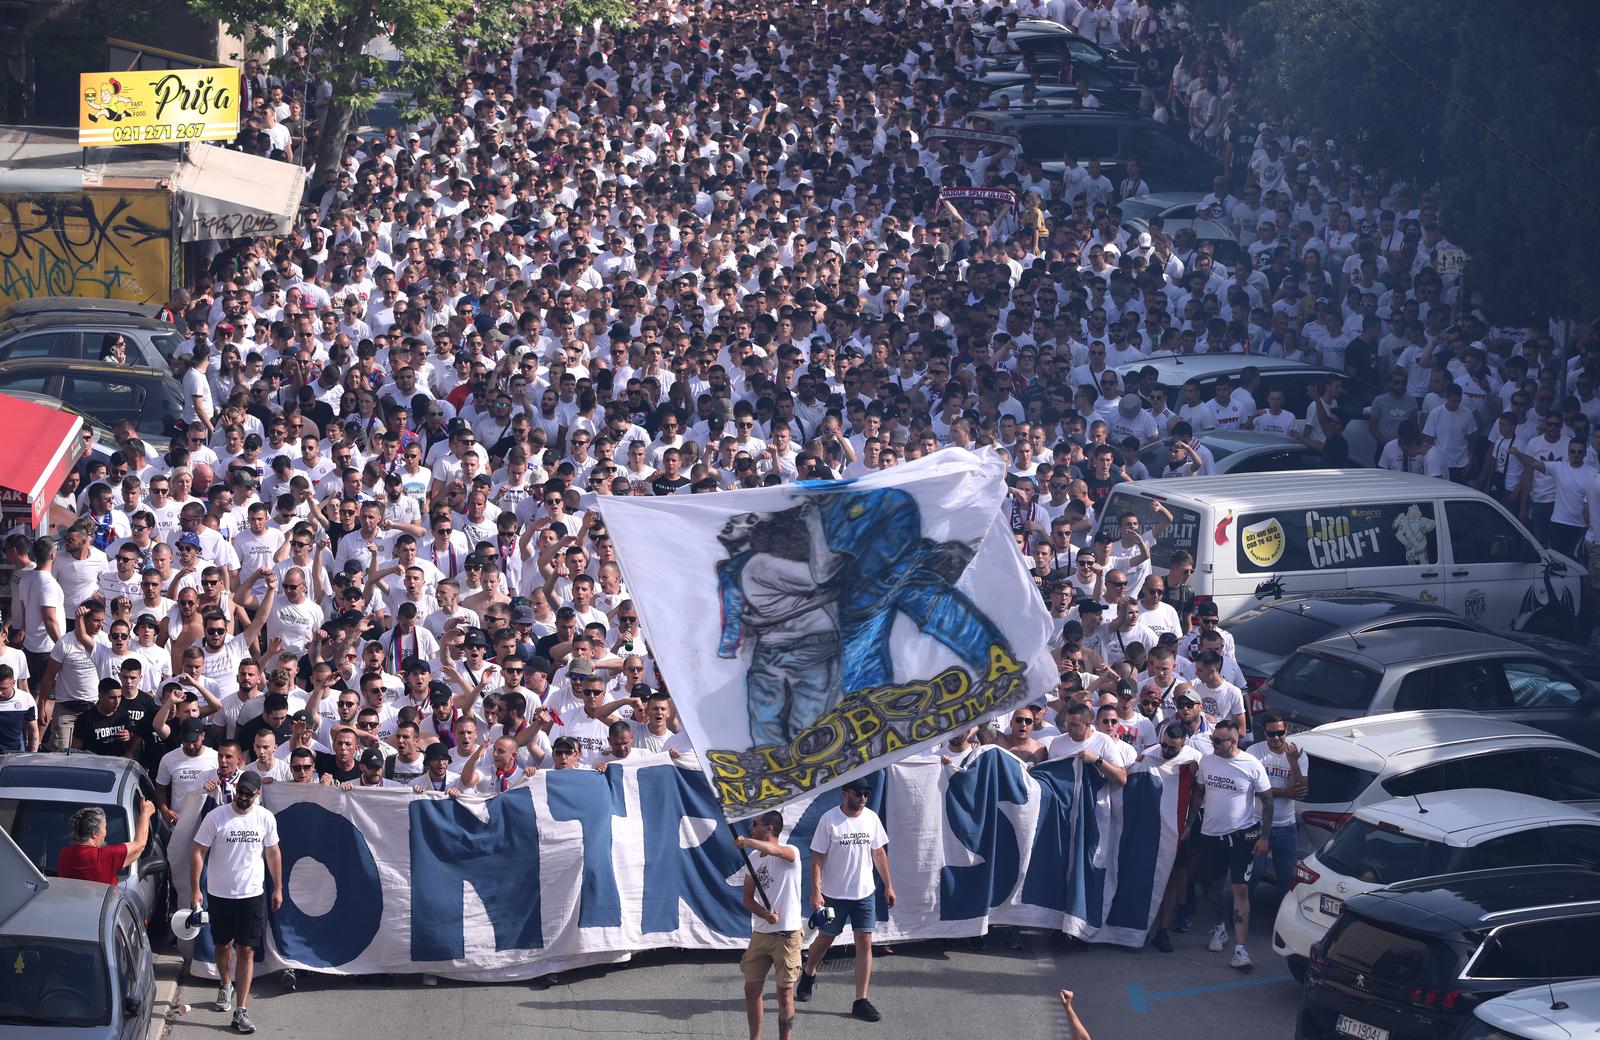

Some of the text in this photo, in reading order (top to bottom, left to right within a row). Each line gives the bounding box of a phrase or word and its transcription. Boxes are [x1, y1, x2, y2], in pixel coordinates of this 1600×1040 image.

[149, 74, 234, 120] Priša
[113, 123, 205, 142] 021 271 267
[1307, 526, 1381, 569] CRAFT
[709, 643, 1021, 780] SLOBODA
[1207, 774, 1235, 785] SLOBODA
[1326, 899, 1335, 912] ST
[1343, 1018, 1352, 1032] ST
